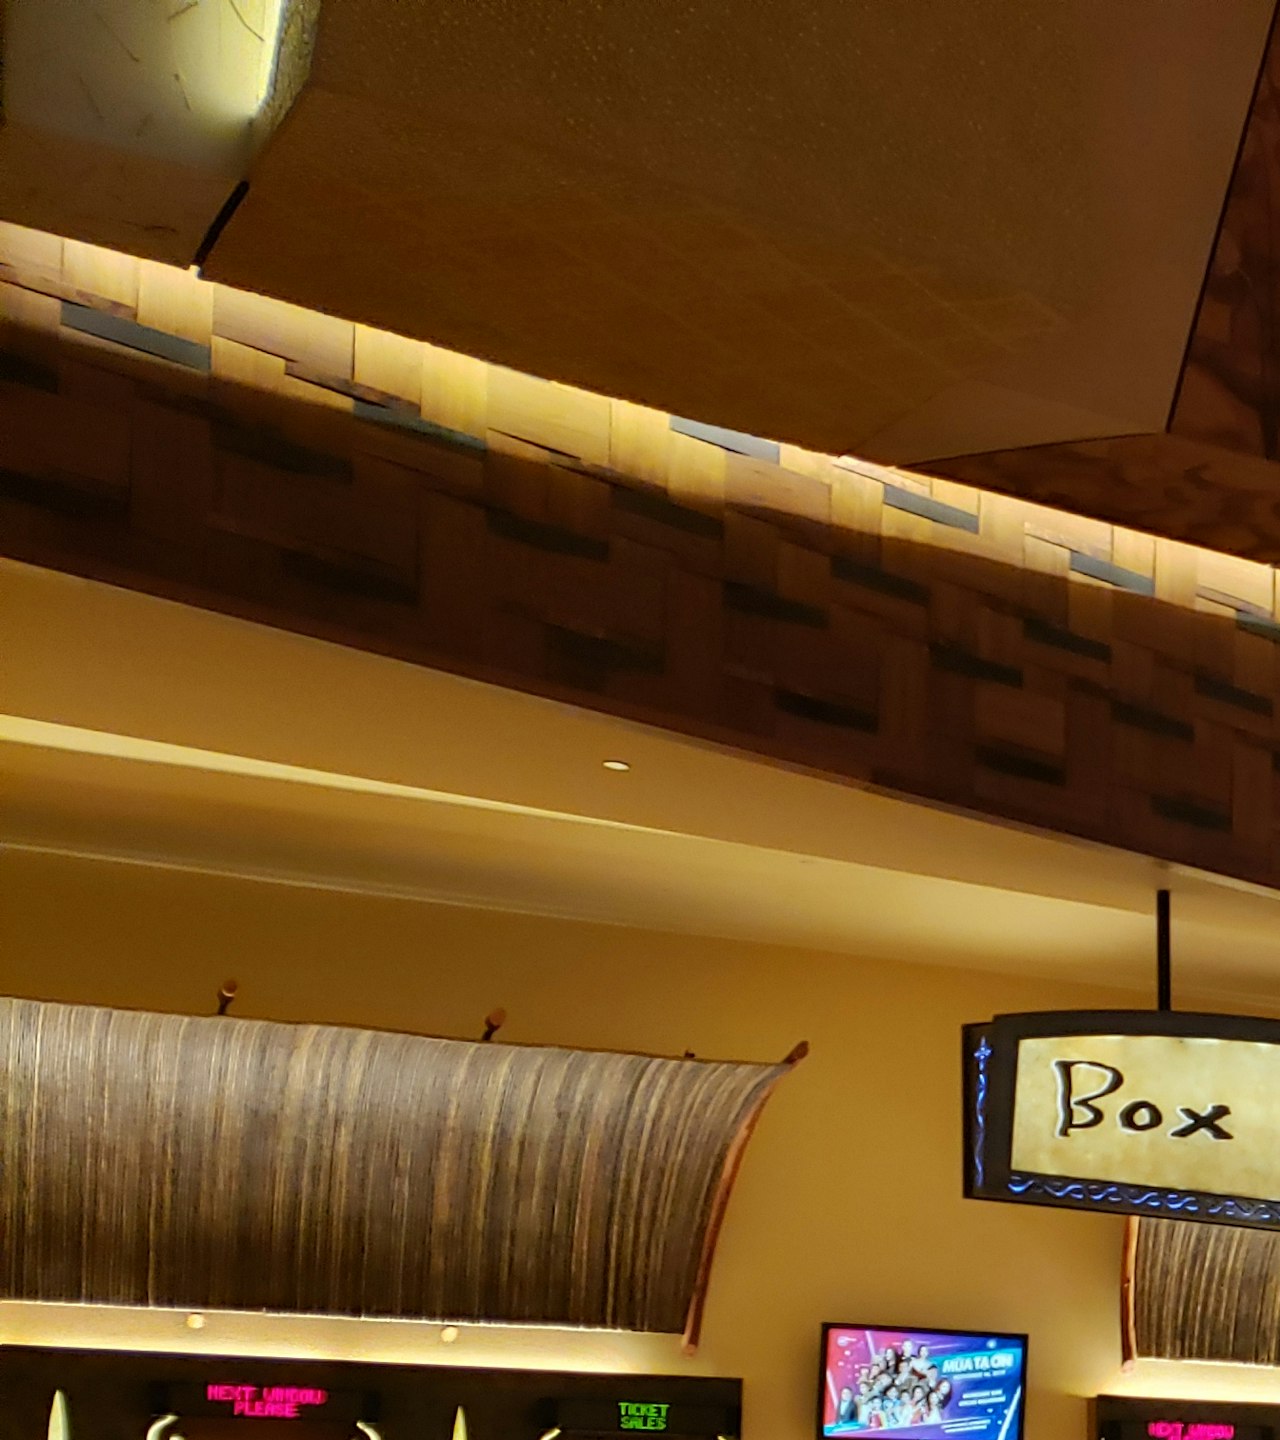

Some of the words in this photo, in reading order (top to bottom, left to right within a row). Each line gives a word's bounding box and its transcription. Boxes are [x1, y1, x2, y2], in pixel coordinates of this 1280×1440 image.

[1053, 1060, 1234, 1140] Box
[618, 1402, 670, 1417] TICKET
[620, 1416, 667, 1430] SALES
